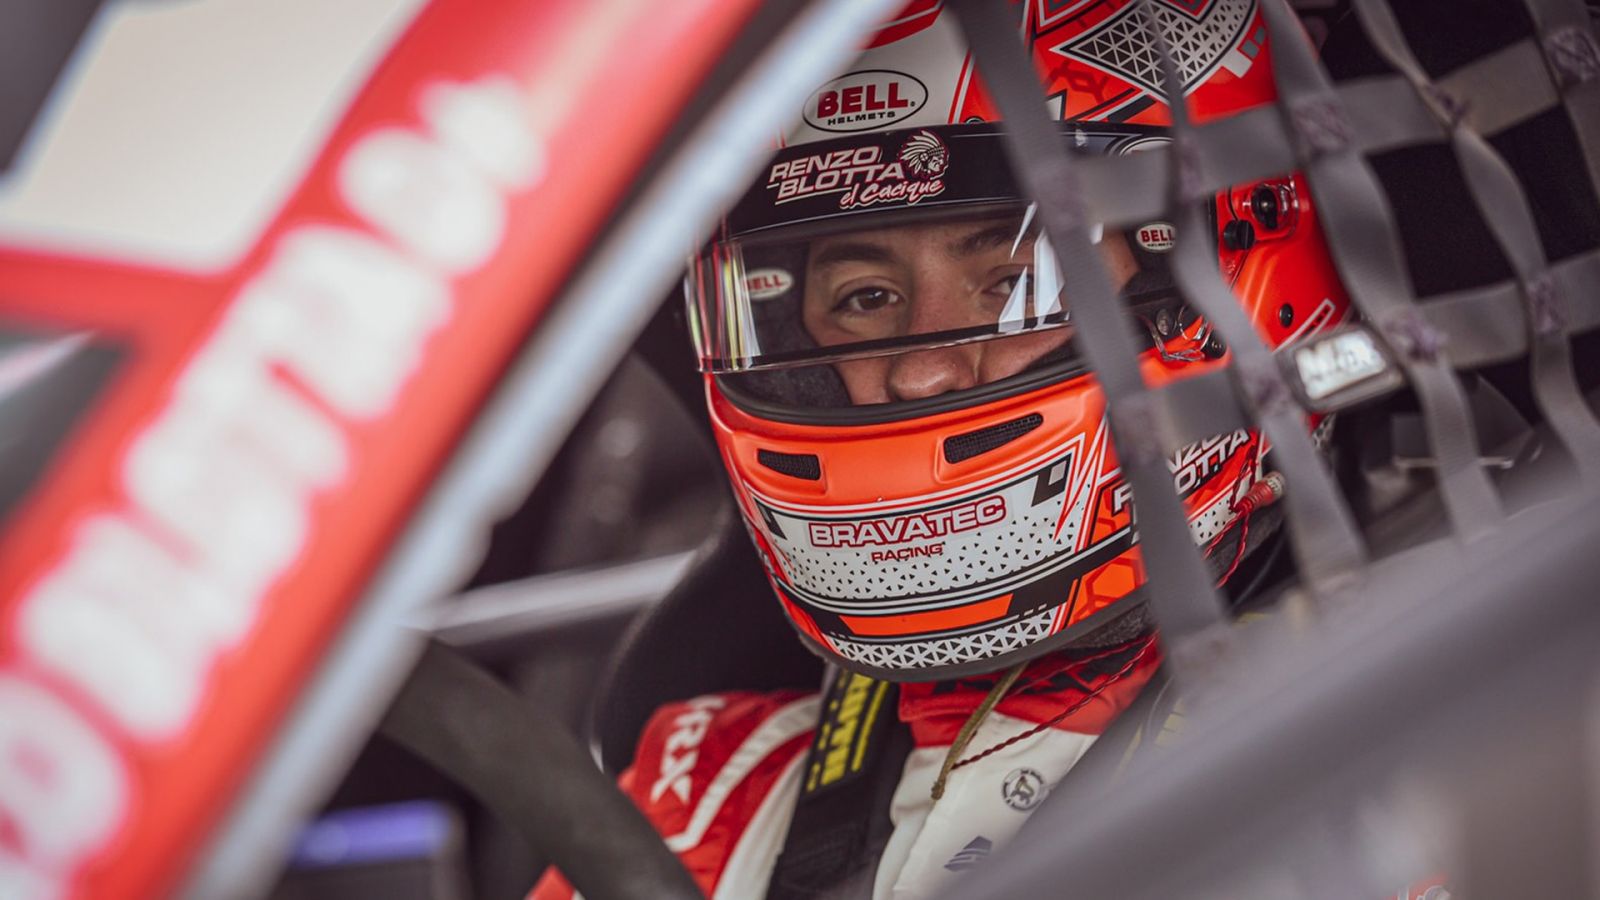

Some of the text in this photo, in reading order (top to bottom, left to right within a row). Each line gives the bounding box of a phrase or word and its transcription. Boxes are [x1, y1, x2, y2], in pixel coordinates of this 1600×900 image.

[817, 82, 909, 119] BELL
[827, 111, 896, 126] HELMETS
[768, 146, 880, 184] RENZO
[777, 162, 905, 200] BLOTTA
[1140, 229, 1175, 243] BELL
[1174, 428, 1250, 495] OTTA
[808, 495, 1007, 548] BRAVATEC
[871, 543, 943, 562] RACING
